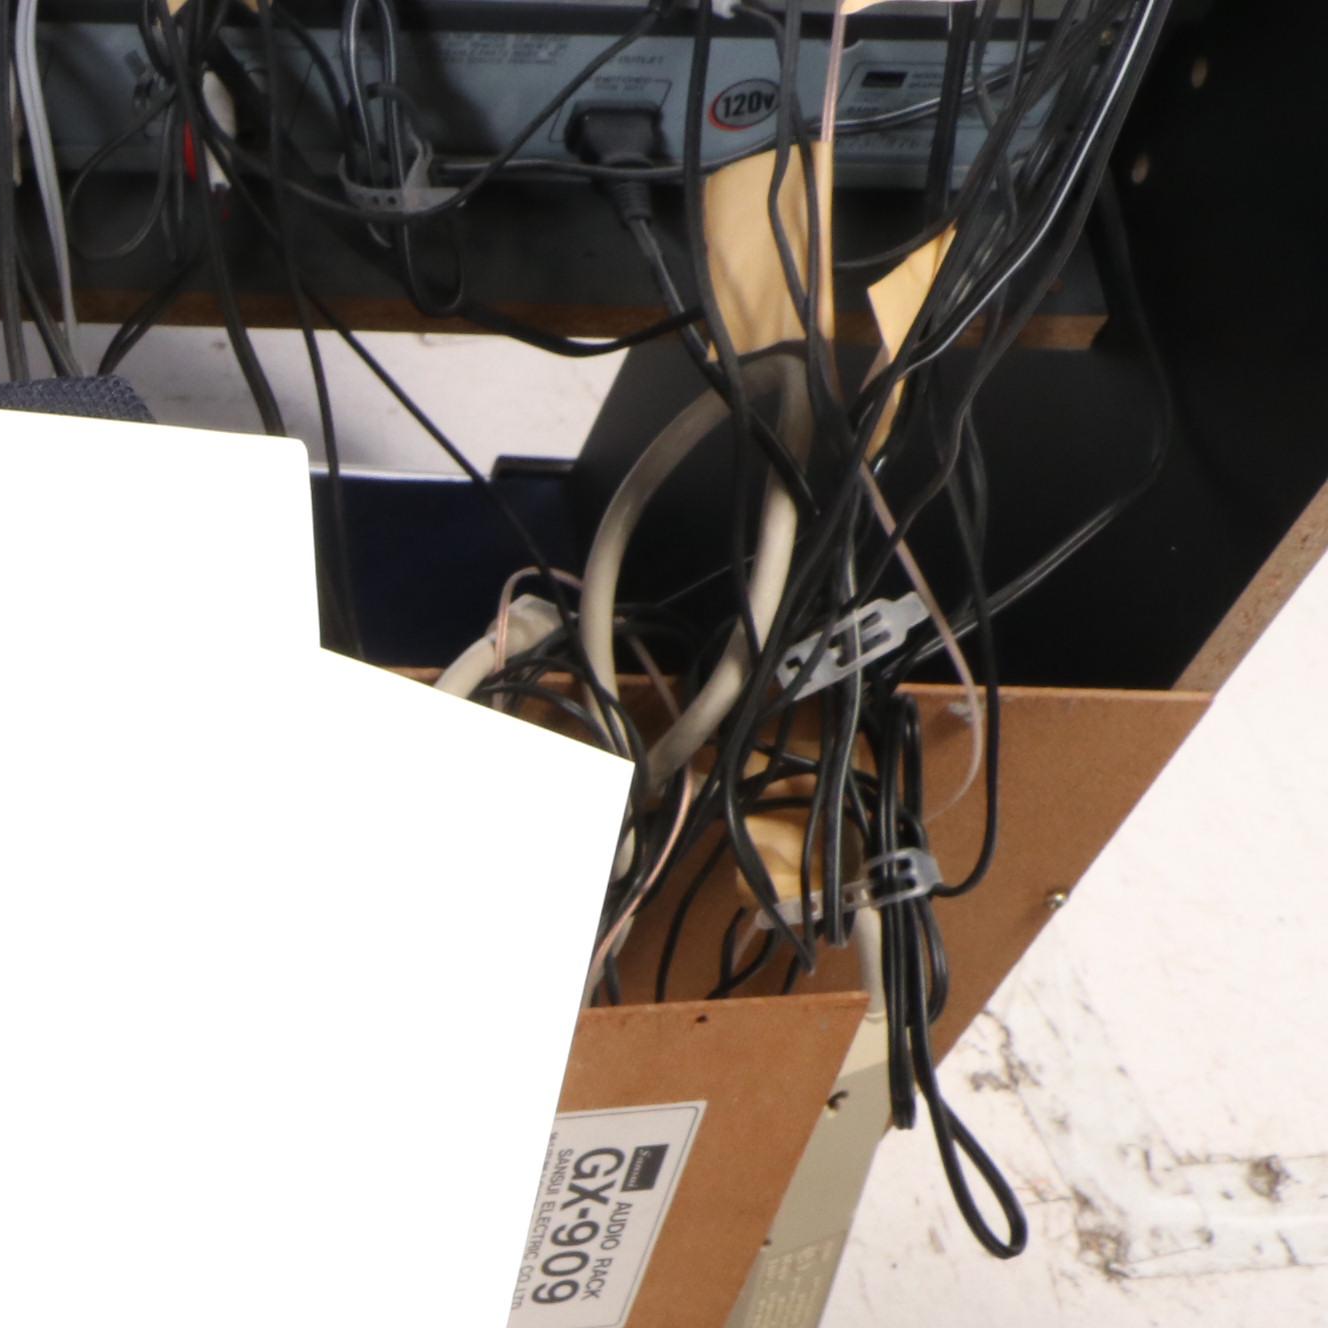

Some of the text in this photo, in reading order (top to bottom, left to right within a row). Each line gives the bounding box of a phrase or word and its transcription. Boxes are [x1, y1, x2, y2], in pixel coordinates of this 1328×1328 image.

[546, 1148, 573, 1196] SANSUI
[524, 1200, 556, 1261] ELECTRIC
[531, 1146, 625, 1305] GX-909
[581, 1201, 633, 1300] AUDIO RACK
